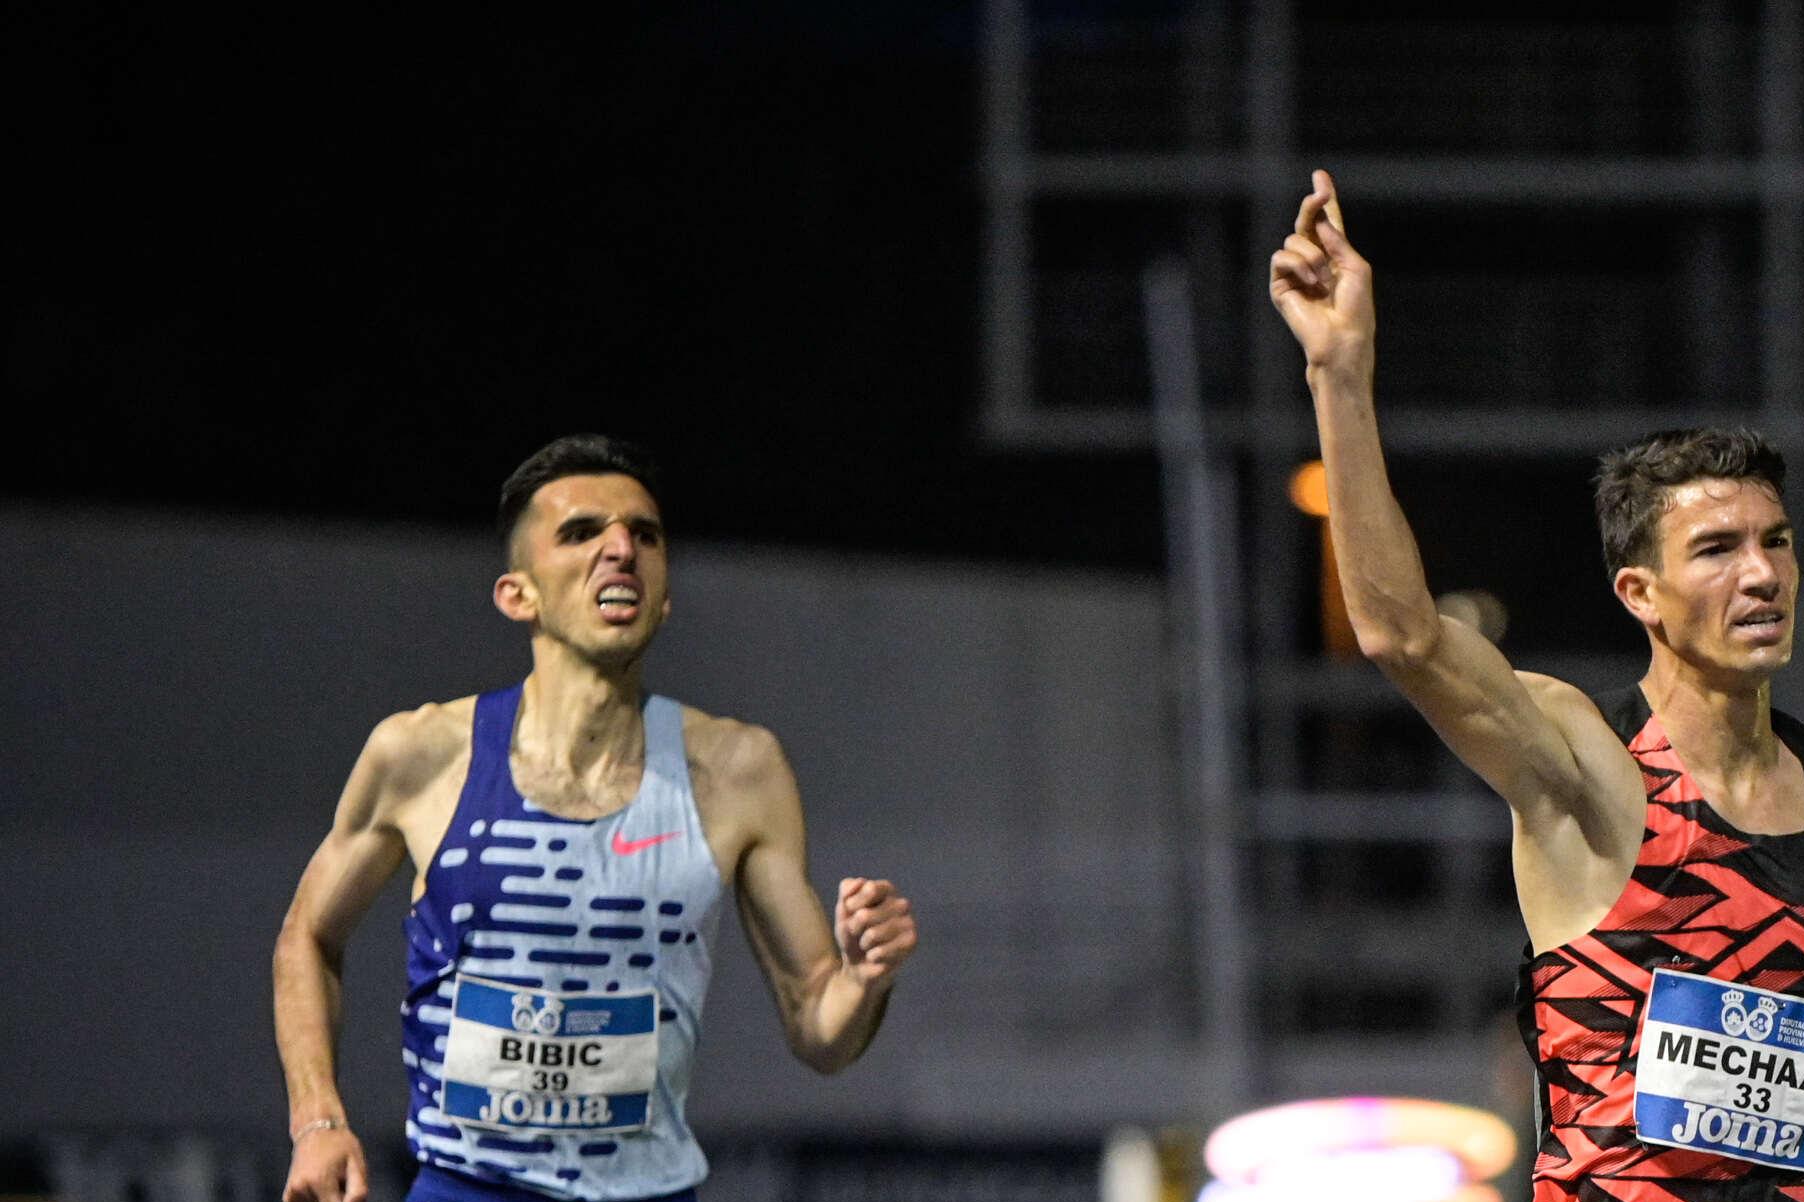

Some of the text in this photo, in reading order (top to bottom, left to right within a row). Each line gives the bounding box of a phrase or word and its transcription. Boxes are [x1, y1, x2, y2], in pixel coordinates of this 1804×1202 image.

[500, 1037, 603, 1067] BIBIC
[532, 1071, 569, 1092] 39
[1733, 1083, 1772, 1113] 33
[1672, 1102, 1803, 1159] Joma
